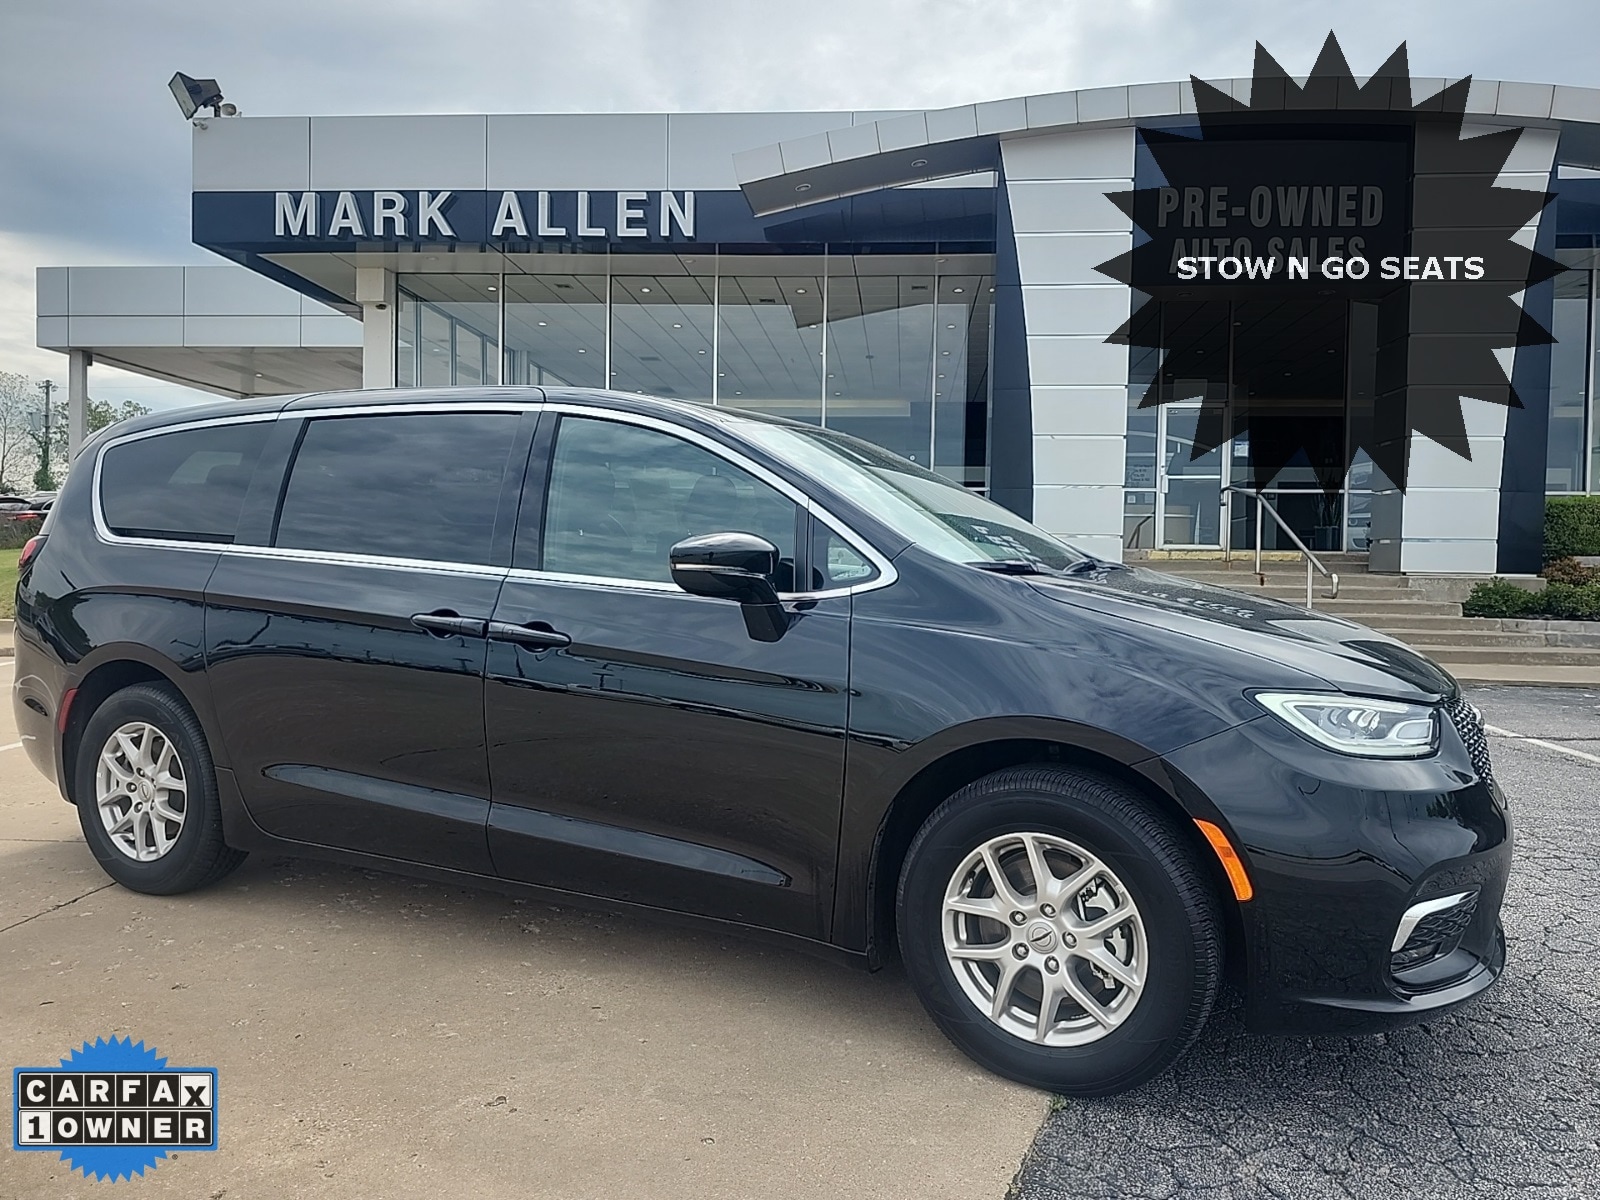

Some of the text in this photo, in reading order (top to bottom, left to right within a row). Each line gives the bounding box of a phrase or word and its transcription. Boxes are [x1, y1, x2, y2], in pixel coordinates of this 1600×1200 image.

[275, 191, 695, 237] MARK ALLEN
[1157, 185, 1384, 228] PRE-OWNED
[1168, 235, 1367, 274] AUTO SALES
